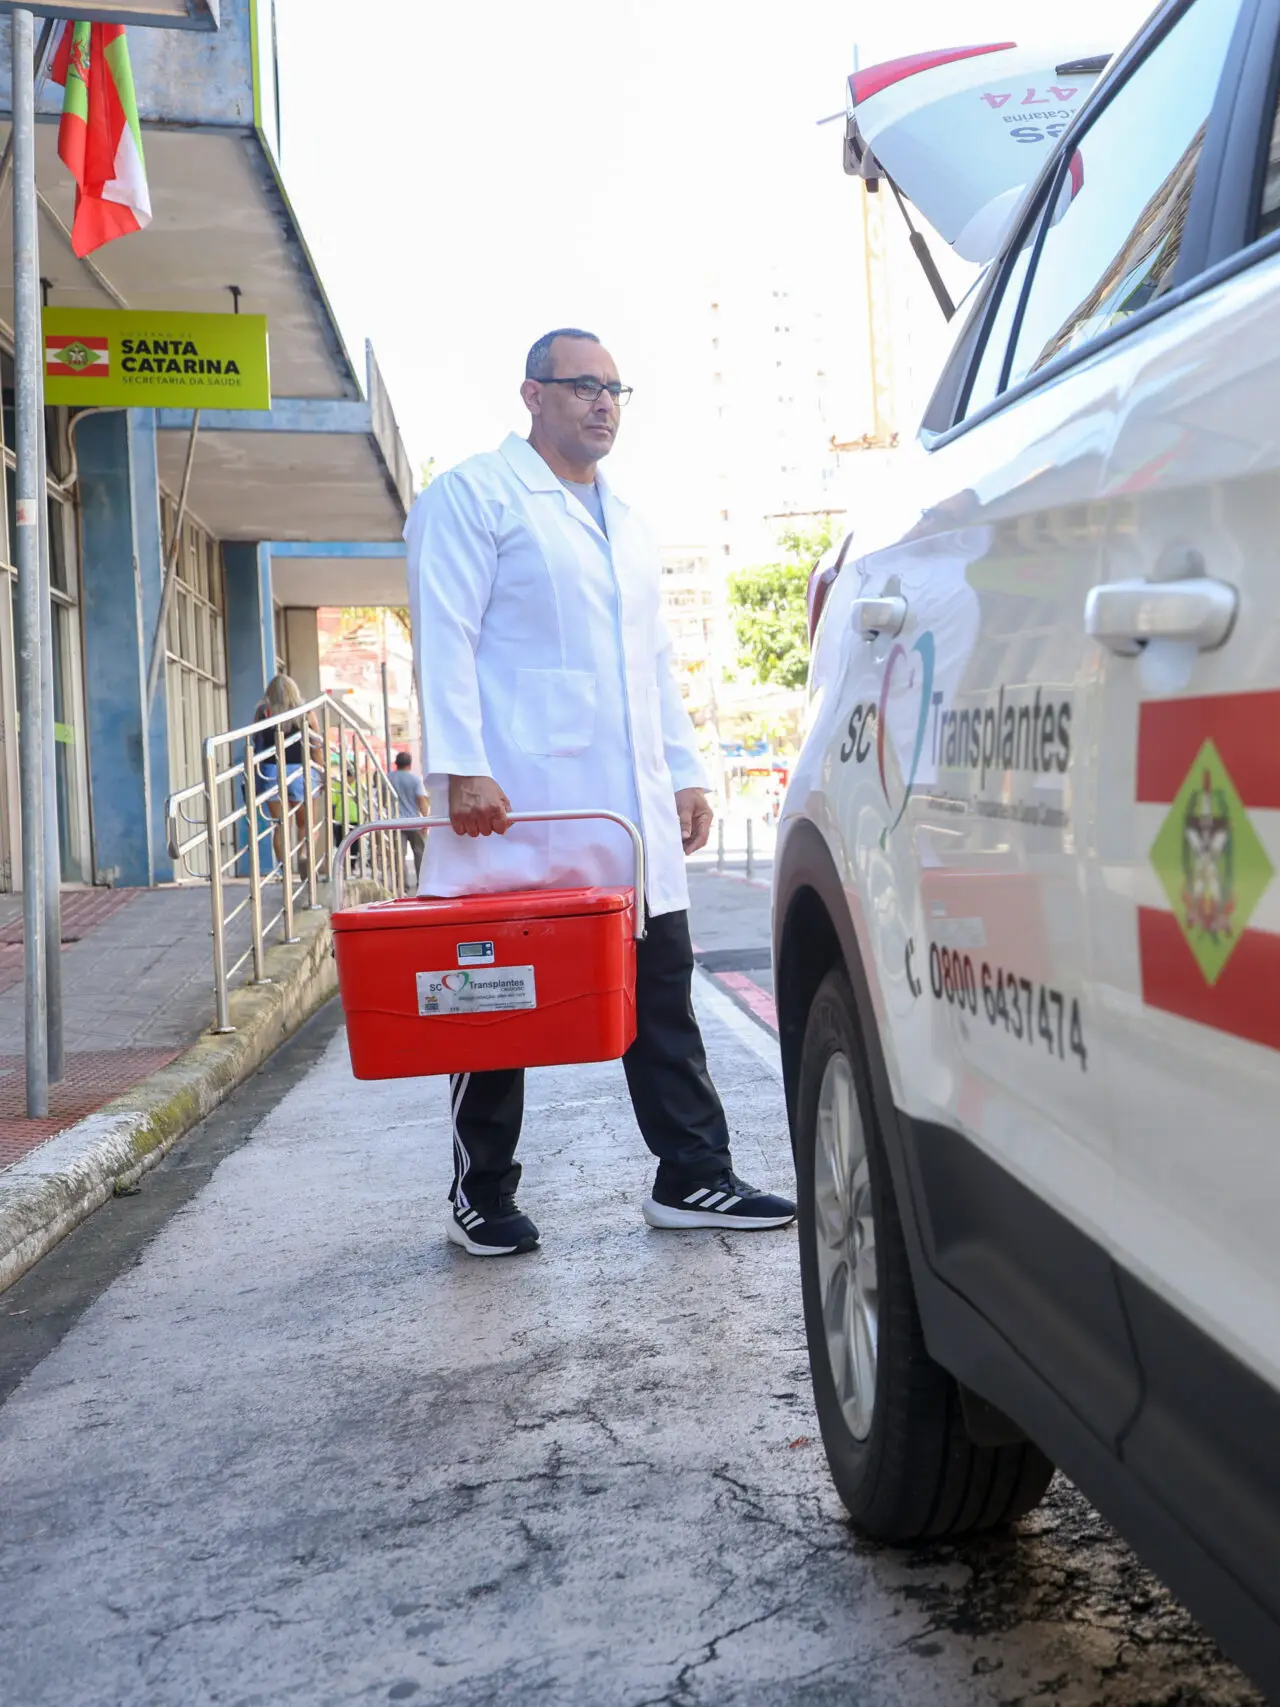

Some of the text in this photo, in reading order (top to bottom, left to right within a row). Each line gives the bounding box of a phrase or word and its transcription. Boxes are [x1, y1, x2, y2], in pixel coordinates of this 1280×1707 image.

[121, 339, 198, 356] SANTA
[121, 357, 240, 375] CATARINA
[122, 376, 186, 386] SECRETARIA
[189, 377, 205, 386] DA
[840, 684, 1072, 790] SC Transplantes
[429, 983, 442, 992] SC
[470, 979, 524, 990] Transplantes
[929, 941, 978, 1016] 0800
